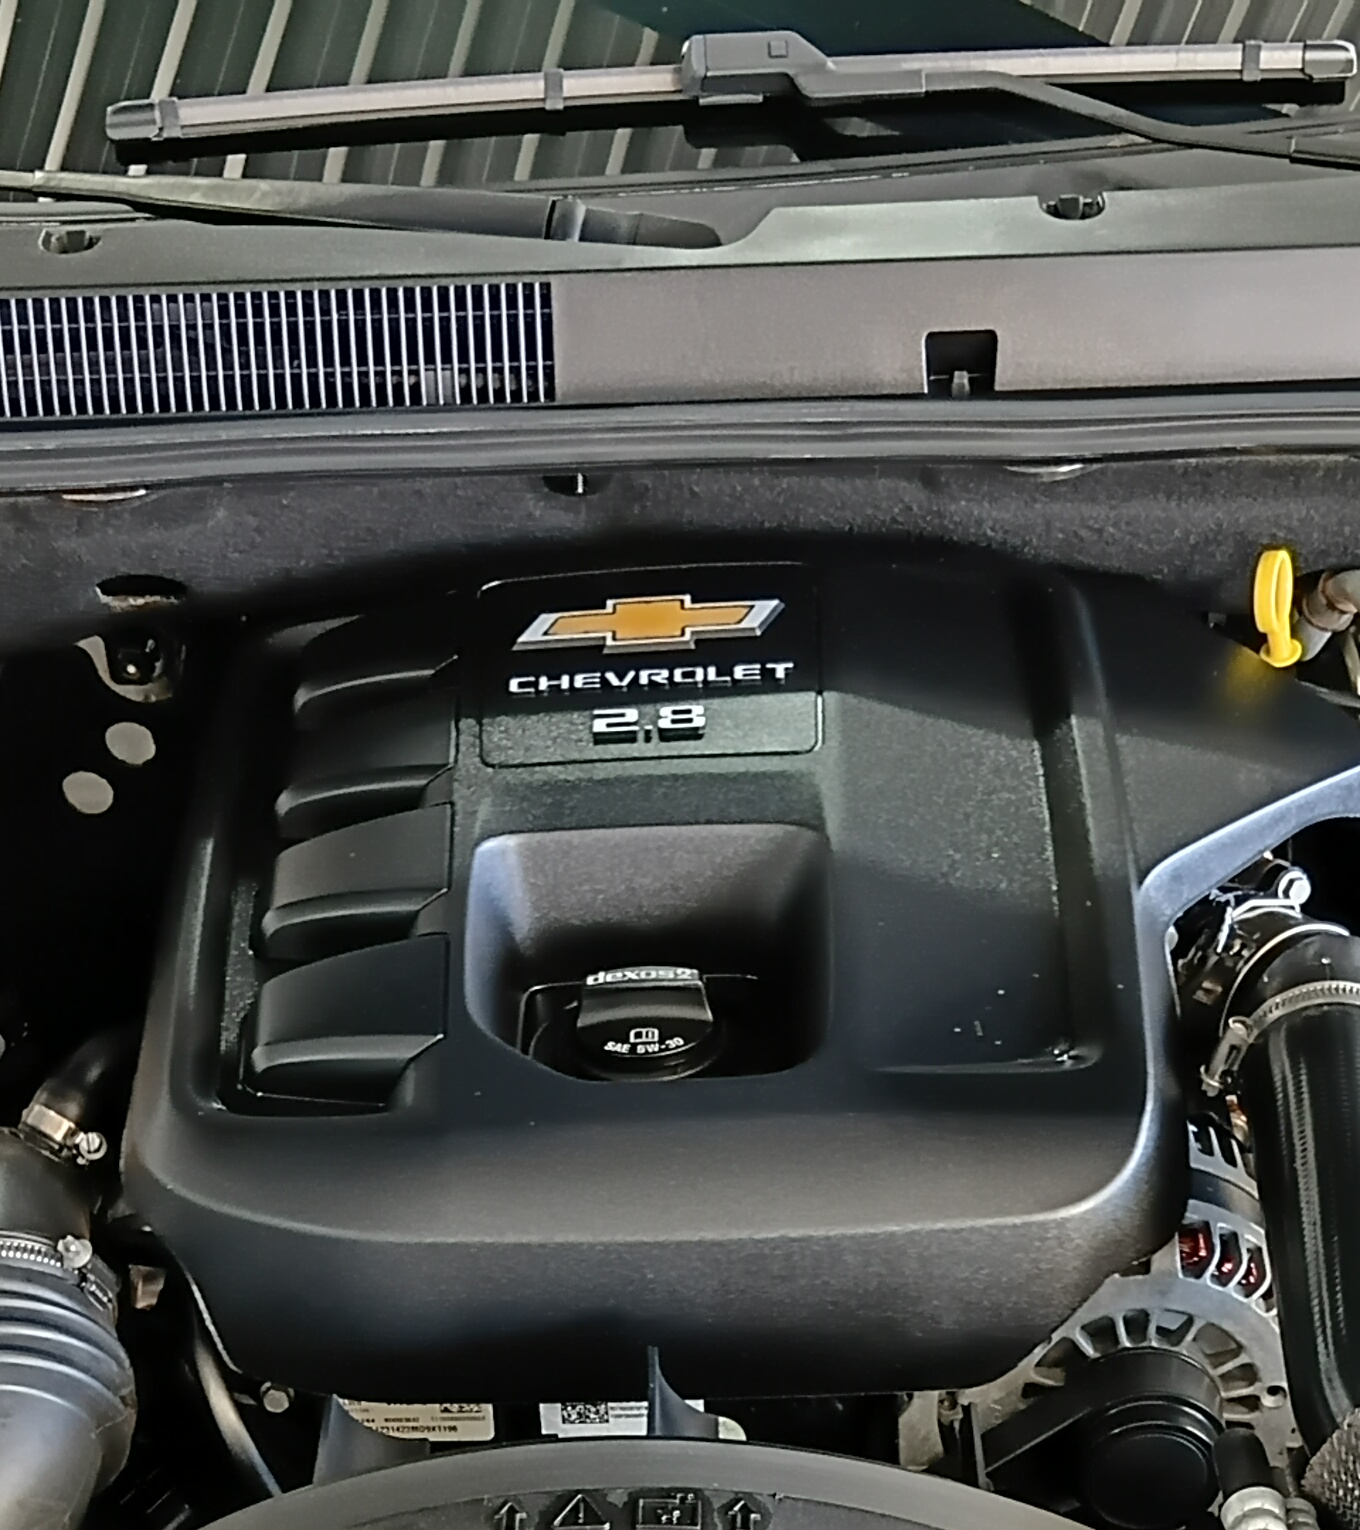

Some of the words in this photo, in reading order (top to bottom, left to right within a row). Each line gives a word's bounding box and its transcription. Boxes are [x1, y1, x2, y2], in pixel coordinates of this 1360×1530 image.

[508, 661, 795, 695] CHEVROLET
[592, 705, 706, 743] 2.8
[586, 968, 696, 986] dexos2
[604, 1040, 631, 1054] SAE
[636, 1037, 685, 1055] 5W-30
